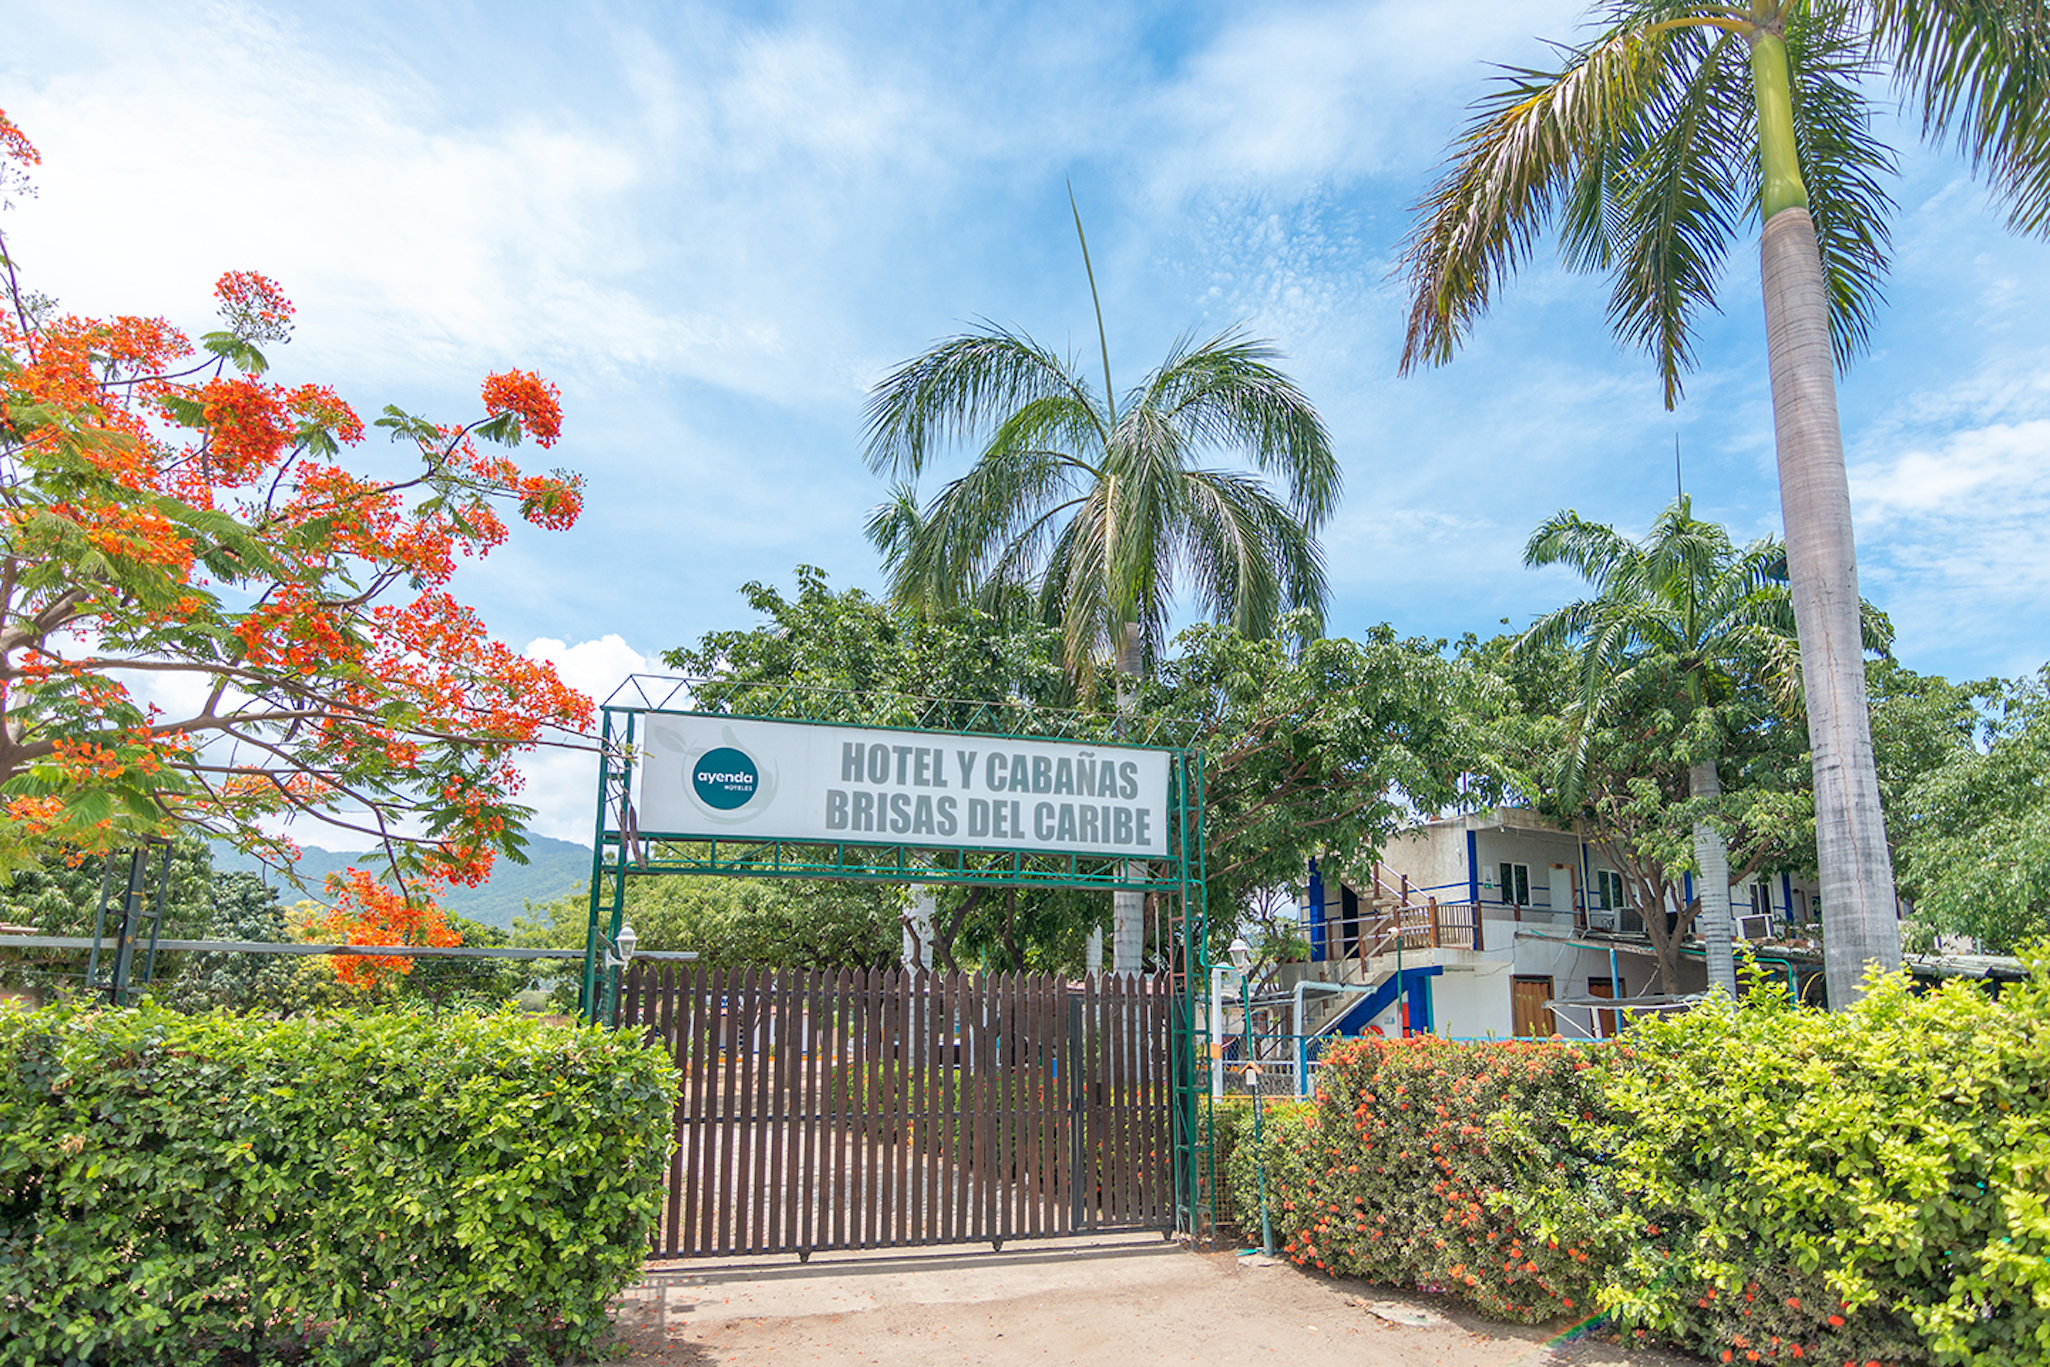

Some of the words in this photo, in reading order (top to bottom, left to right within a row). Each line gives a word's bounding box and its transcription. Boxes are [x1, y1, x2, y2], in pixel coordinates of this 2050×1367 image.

[697, 771, 753, 785] ayenda
[724, 784, 753, 792] HOTELES
[842, 742, 948, 788] HOTEL
[956, 750, 978, 789] Y
[985, 751, 1139, 800] CABAÑAS
[826, 789, 958, 837] BRISAS
[968, 798, 1026, 839] DEL
[1034, 801, 1152, 846] CARIBE
